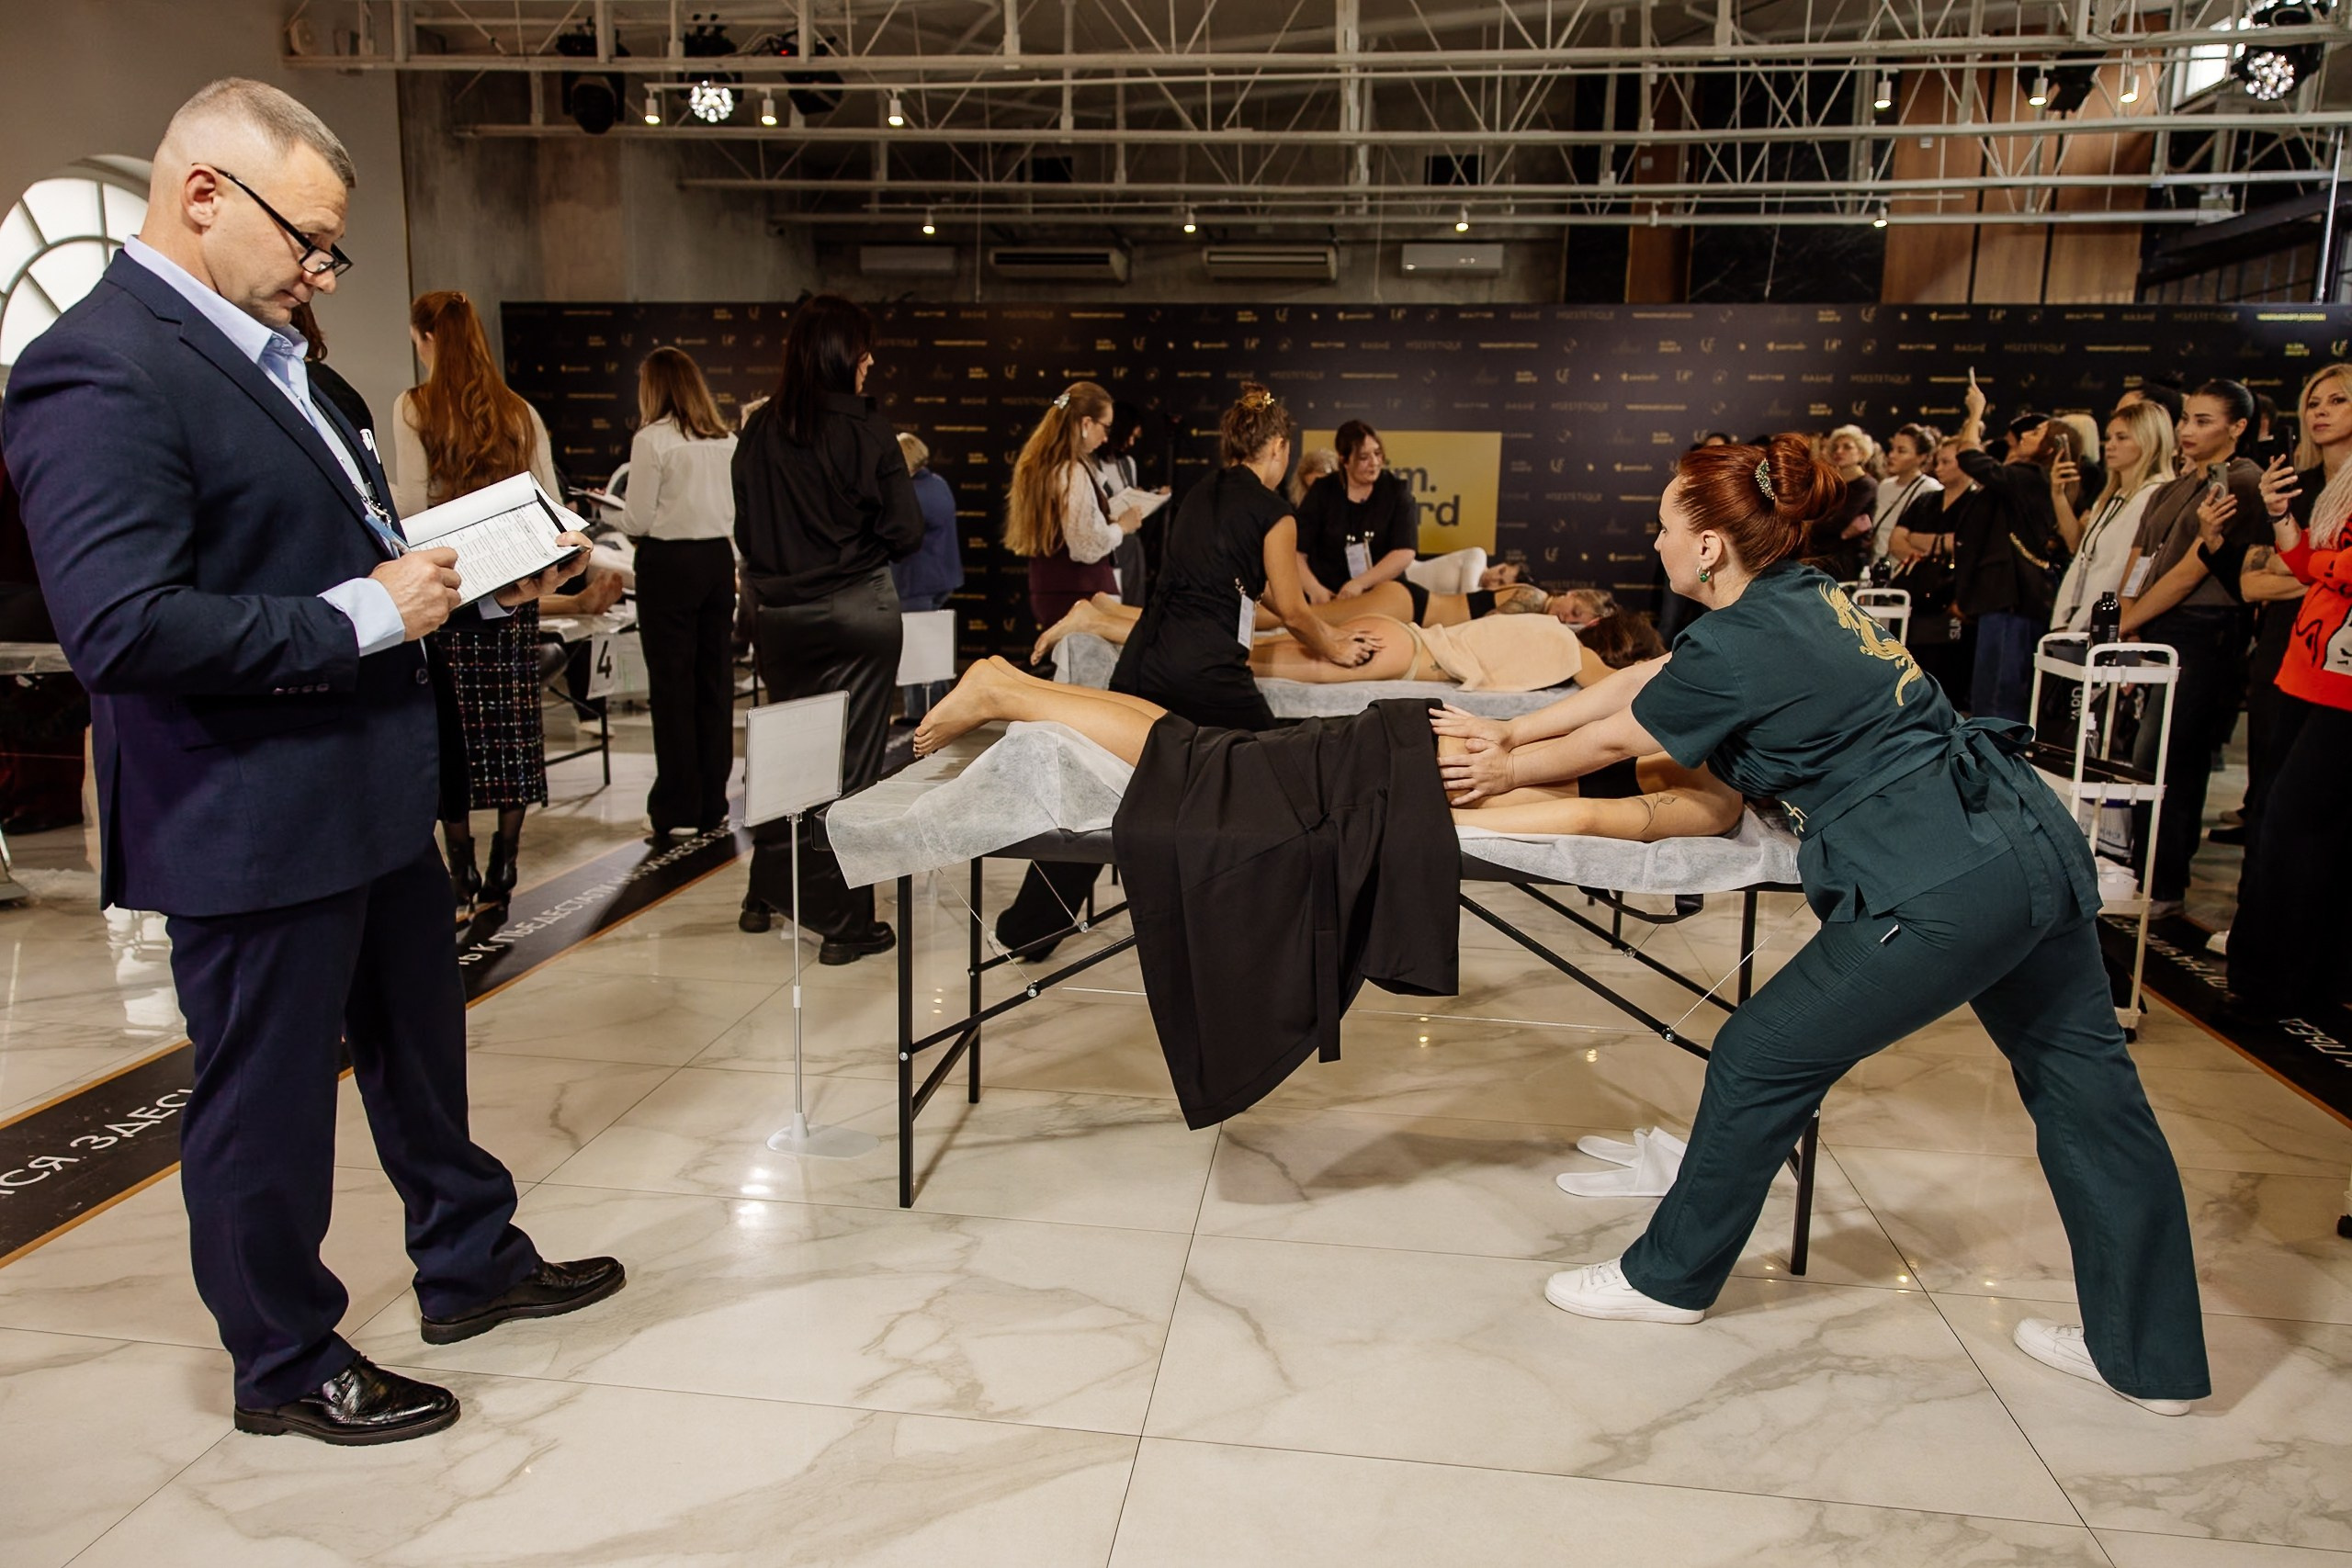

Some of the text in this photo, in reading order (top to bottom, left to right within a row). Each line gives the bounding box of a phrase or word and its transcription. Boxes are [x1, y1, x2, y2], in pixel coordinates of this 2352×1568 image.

[1415, 494, 1461, 526] rd
[596, 639, 612, 679] 4
[0, 1155, 80, 1195] СЯ
